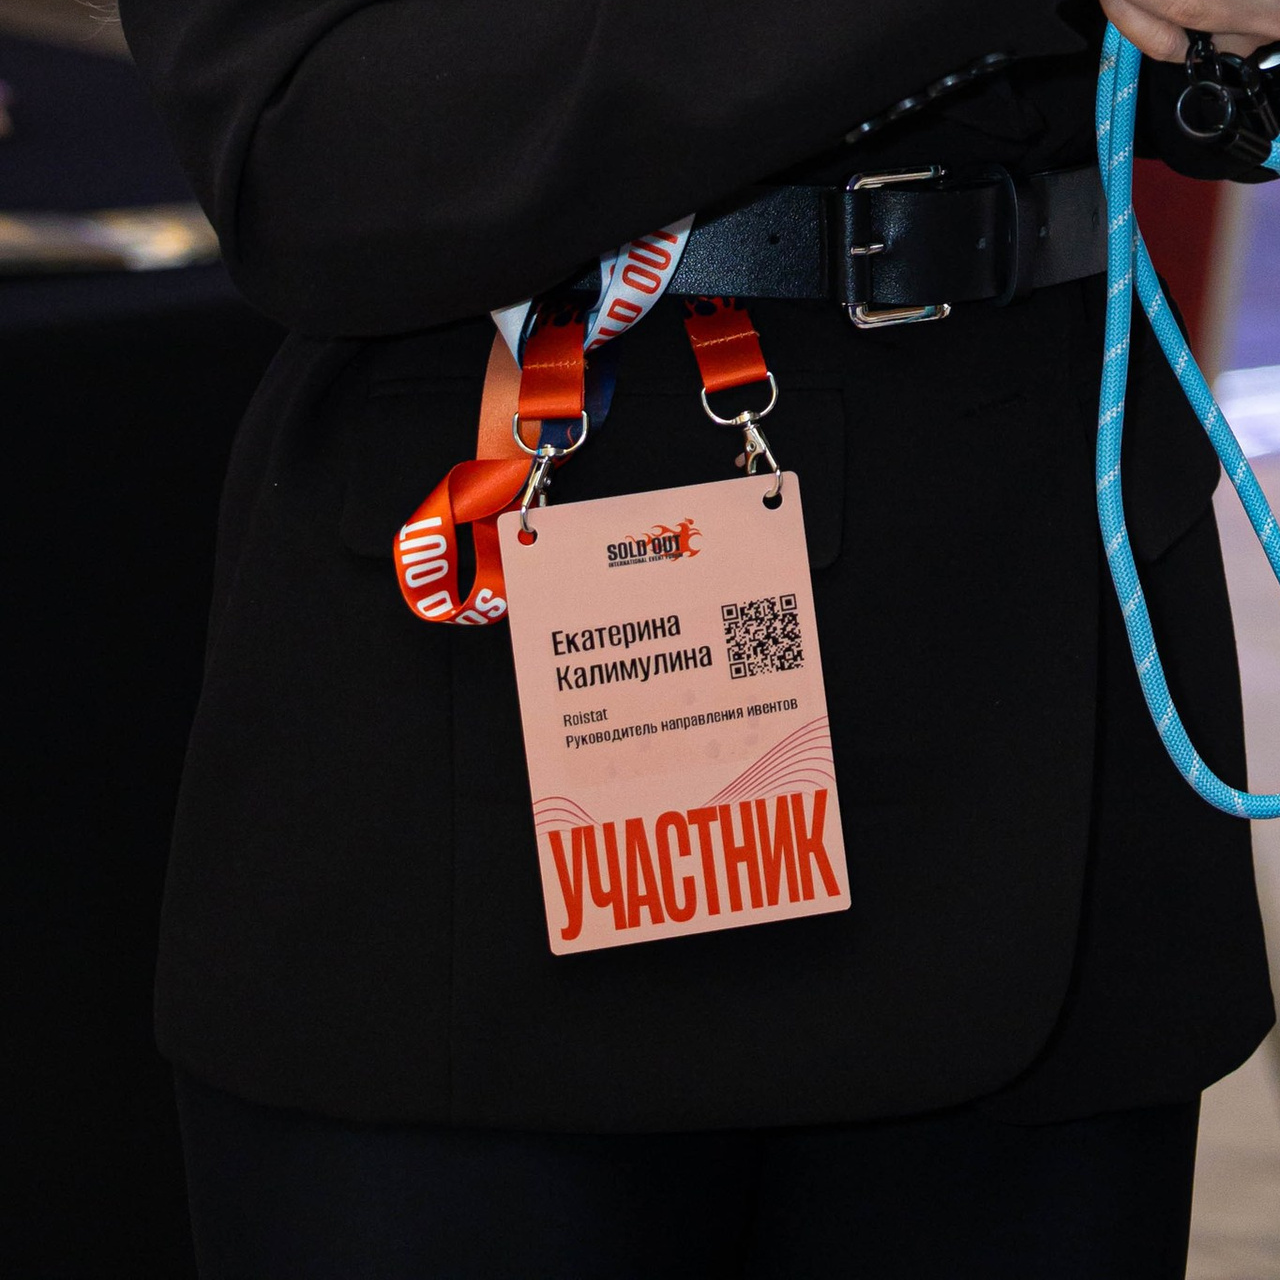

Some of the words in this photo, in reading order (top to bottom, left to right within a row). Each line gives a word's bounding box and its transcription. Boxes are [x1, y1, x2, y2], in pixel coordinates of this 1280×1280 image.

[399, 516, 449, 589] OUT
[606, 539, 648, 562] SOLD
[651, 534, 682, 555] OUT
[608, 558, 648, 568] INTERNATIONAL
[649, 555, 664, 563] EVENT
[551, 614, 682, 656] Екатерина
[556, 645, 713, 692] Калимулина
[563, 708, 609, 727] Roistat
[565, 723, 658, 749] Руководитель
[661, 707, 744, 731] направления
[746, 698, 799, 718] ивентов
[548, 788, 842, 941] УЧАСТНИК
